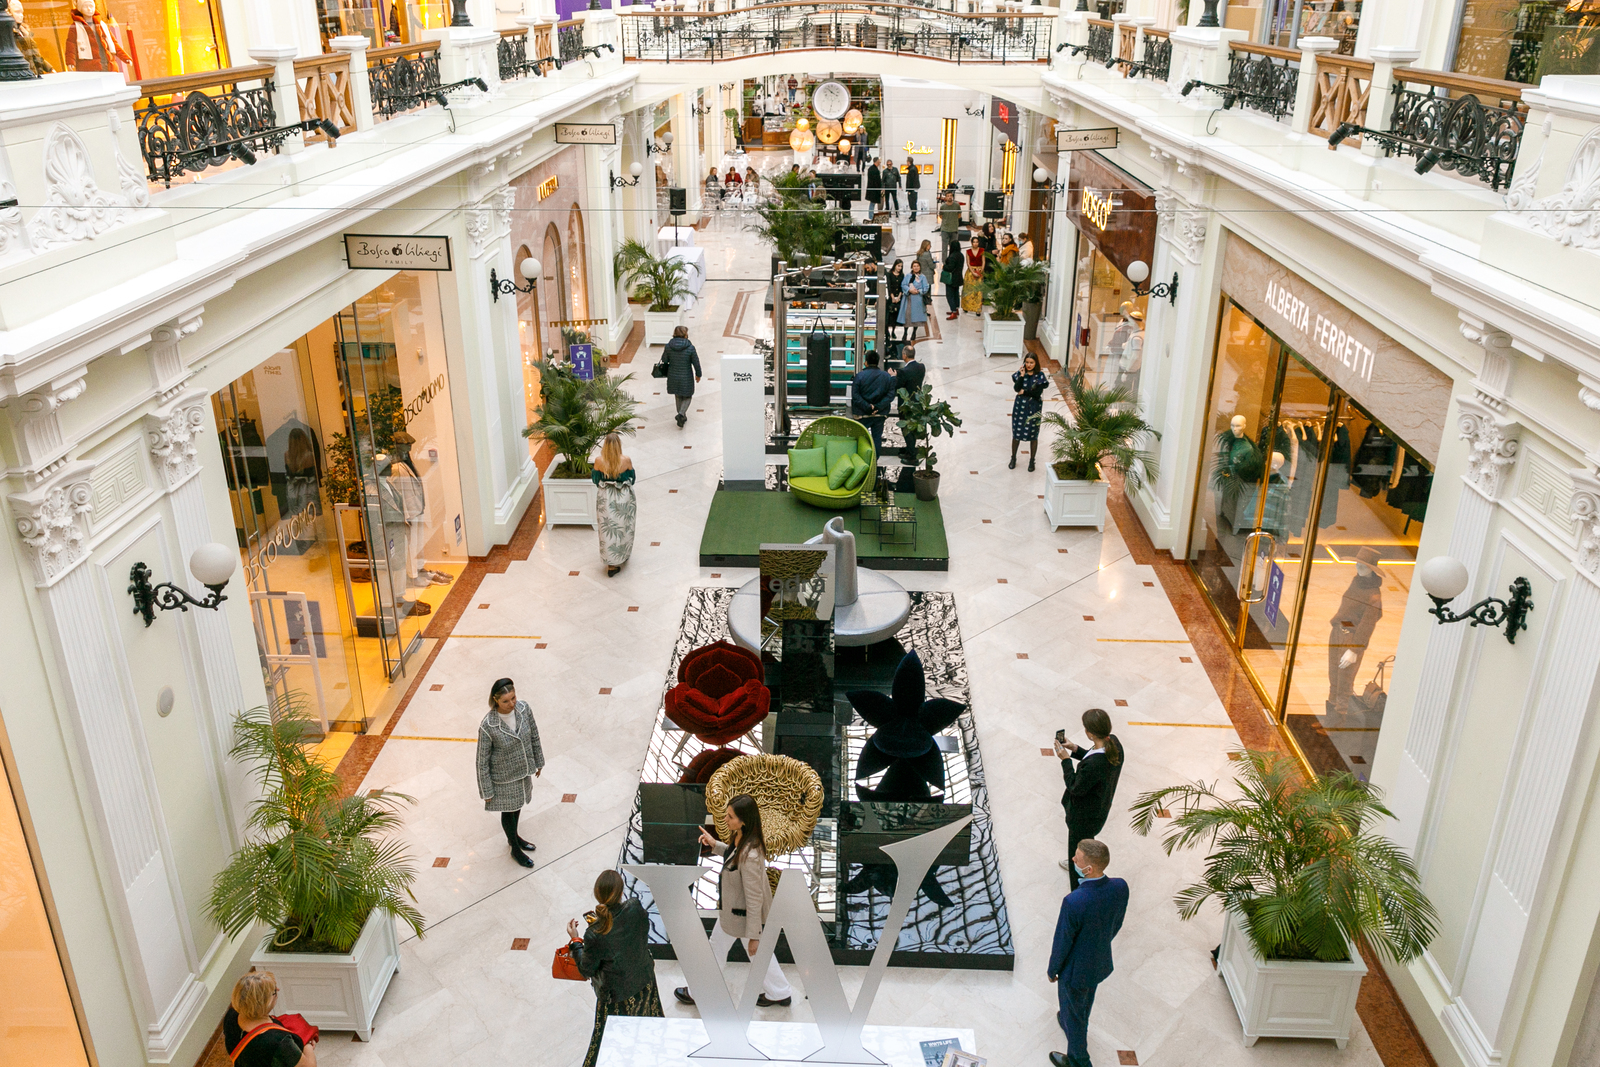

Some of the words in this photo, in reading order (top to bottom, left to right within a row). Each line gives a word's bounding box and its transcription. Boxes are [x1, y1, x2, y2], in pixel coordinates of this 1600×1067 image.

[561, 127, 580, 137] Bosco
[1082, 186, 1108, 231] BOSCO
[357, 242, 390, 258] Bosco
[405, 242, 442, 262] Ciliegi
[1264, 280, 1310, 335] ALBERTA
[1314, 314, 1375, 383] FERRETTI
[400, 395, 423, 426] OSCO
[243, 540, 277, 588] OSCO
[282, 502, 316, 548] UOMO
